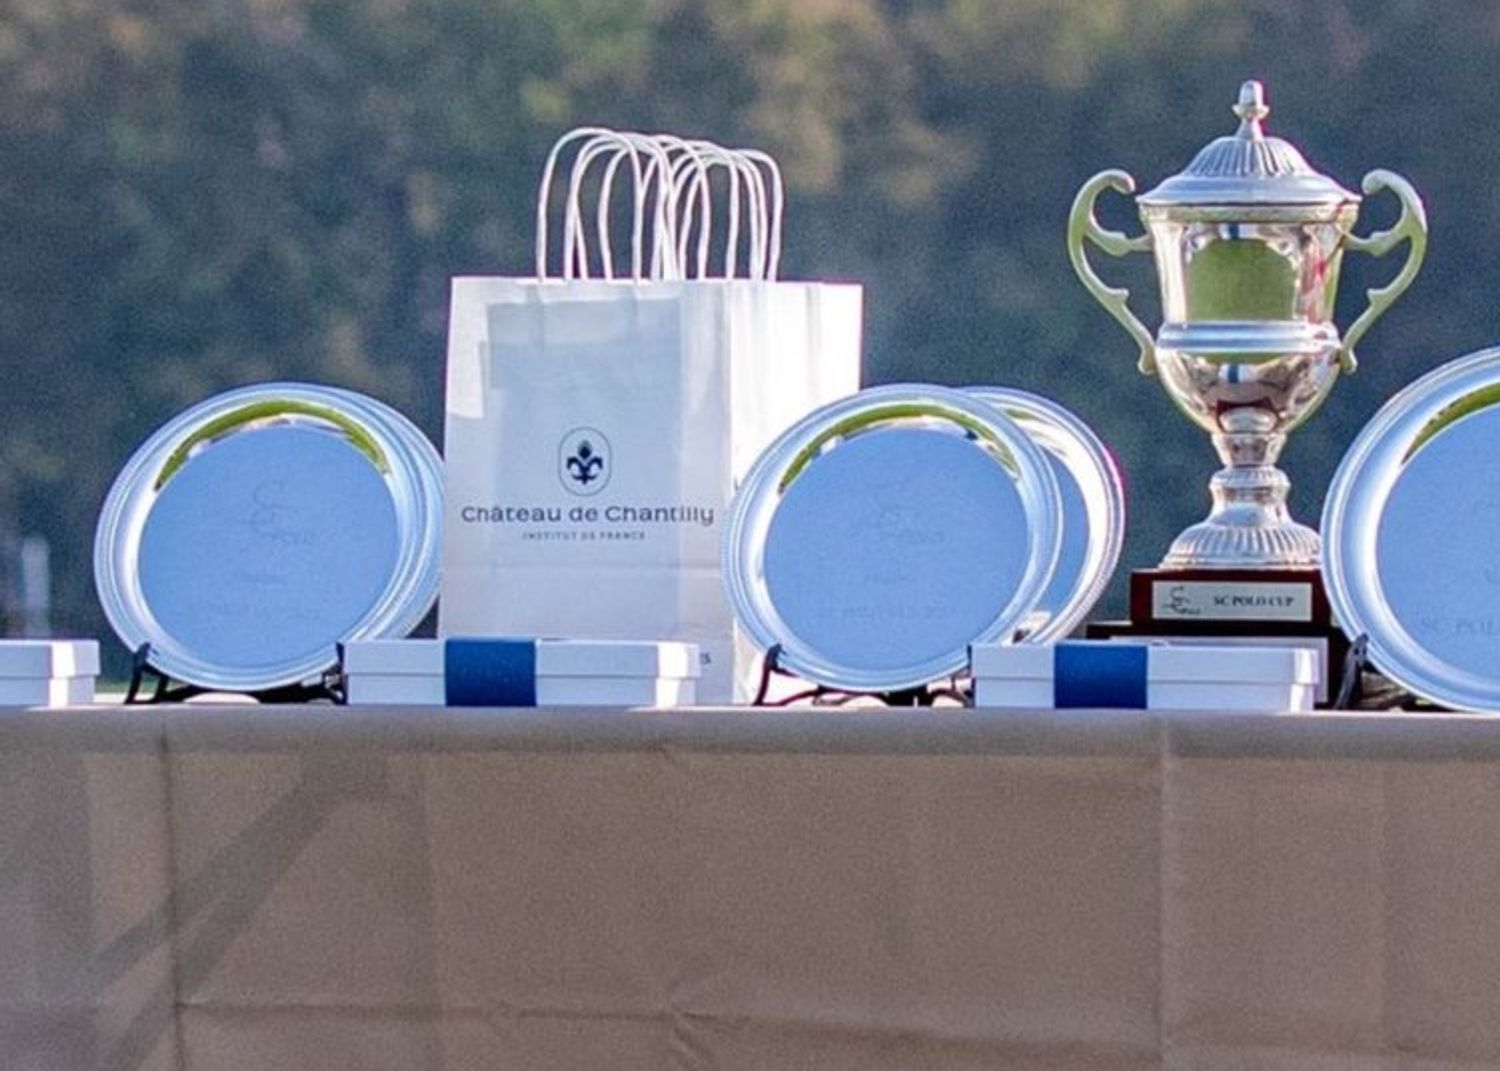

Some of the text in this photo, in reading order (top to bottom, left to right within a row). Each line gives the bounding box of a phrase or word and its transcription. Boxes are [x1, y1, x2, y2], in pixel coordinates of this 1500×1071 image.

[461, 504, 715, 527] Château de Chantilly
[522, 530, 646, 541] INSTITUT DE FRANCE
[1213, 595, 1295, 608] SC POLO CUP
